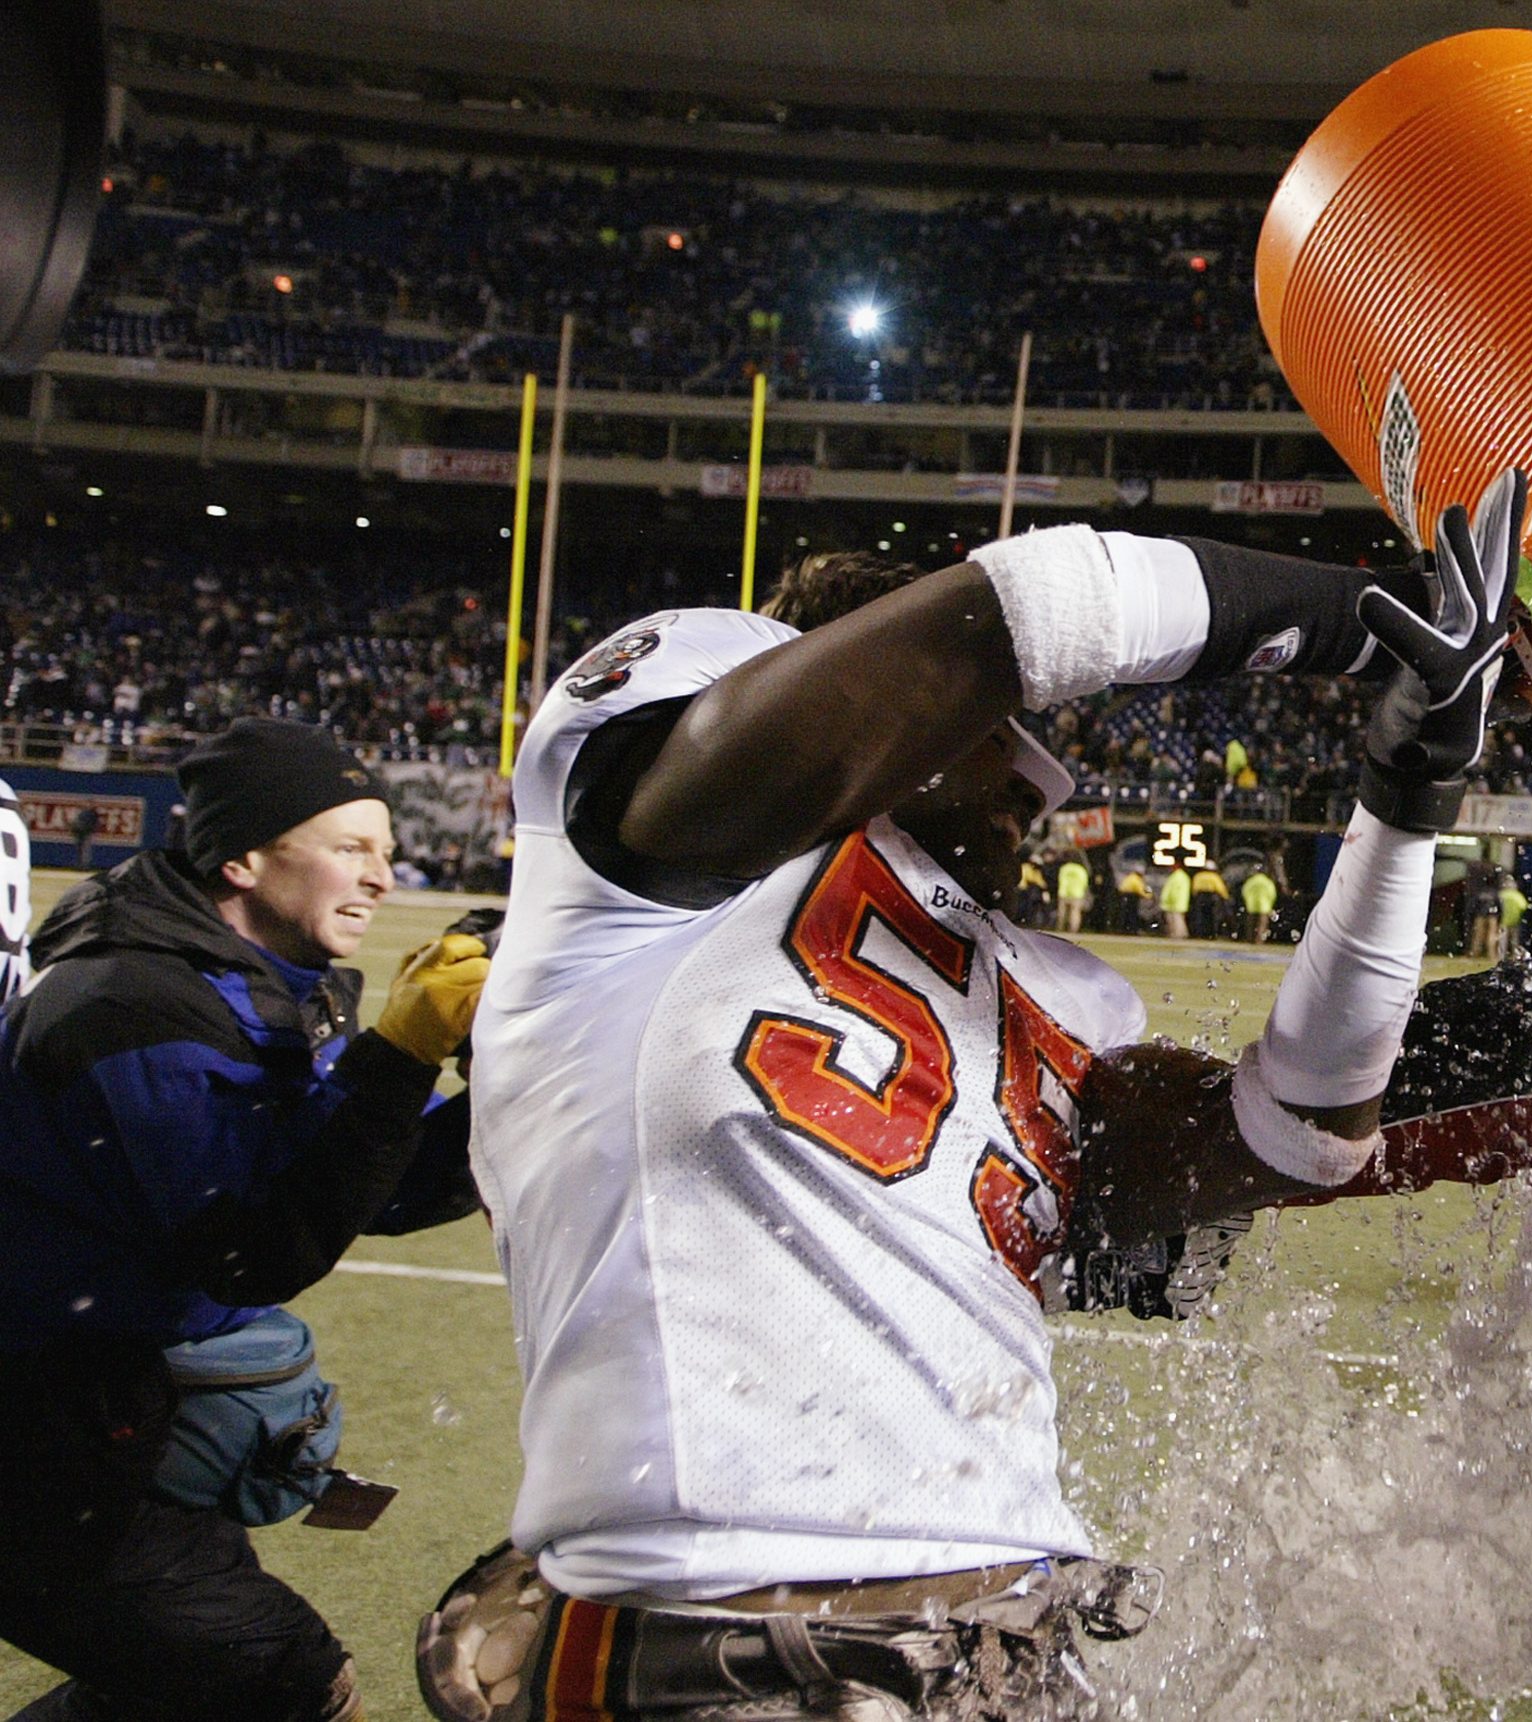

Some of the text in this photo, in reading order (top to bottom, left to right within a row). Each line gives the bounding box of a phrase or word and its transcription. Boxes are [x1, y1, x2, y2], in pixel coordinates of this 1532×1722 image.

[21, 801, 138, 836] PLAYFFS
[1153, 823, 1207, 867] 25
[733, 824, 1094, 1310] 55
